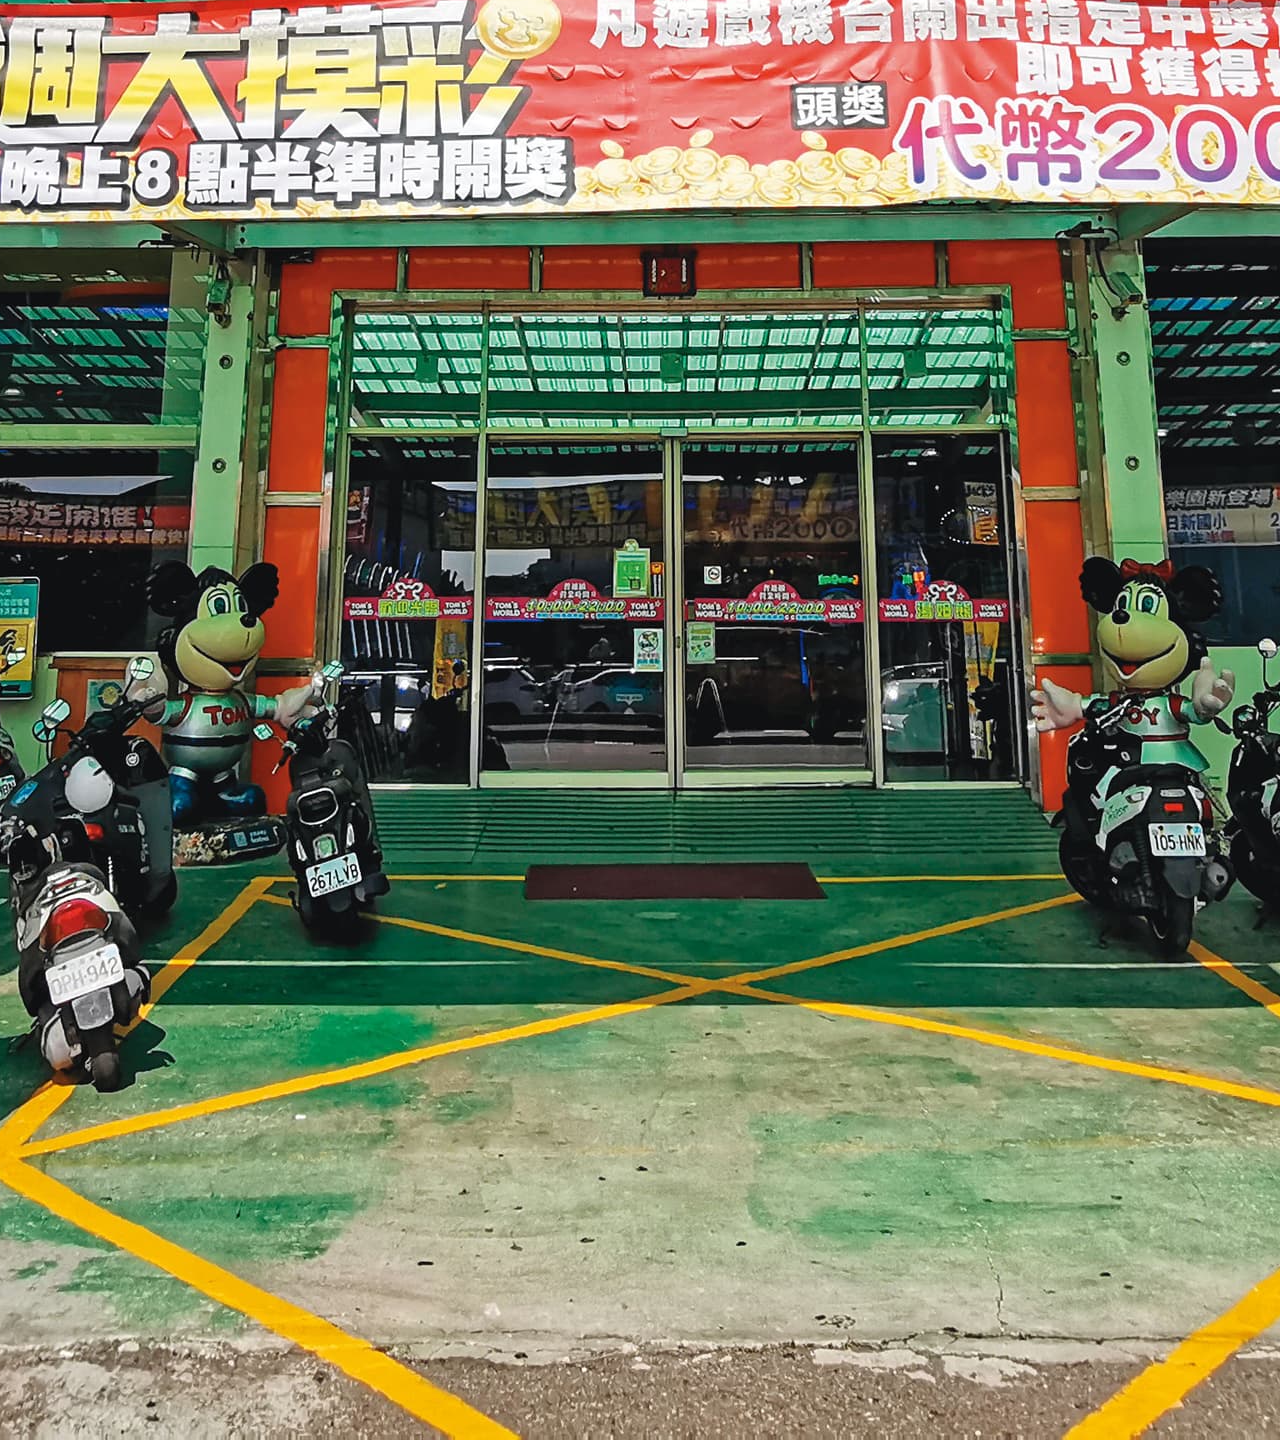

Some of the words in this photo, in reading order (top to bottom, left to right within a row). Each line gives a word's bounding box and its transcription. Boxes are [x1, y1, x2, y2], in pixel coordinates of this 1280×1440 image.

[794, 84, 886, 128] 頭獎
[203, 705, 249, 727] TOM
[1127, 706, 1161, 725] OY
